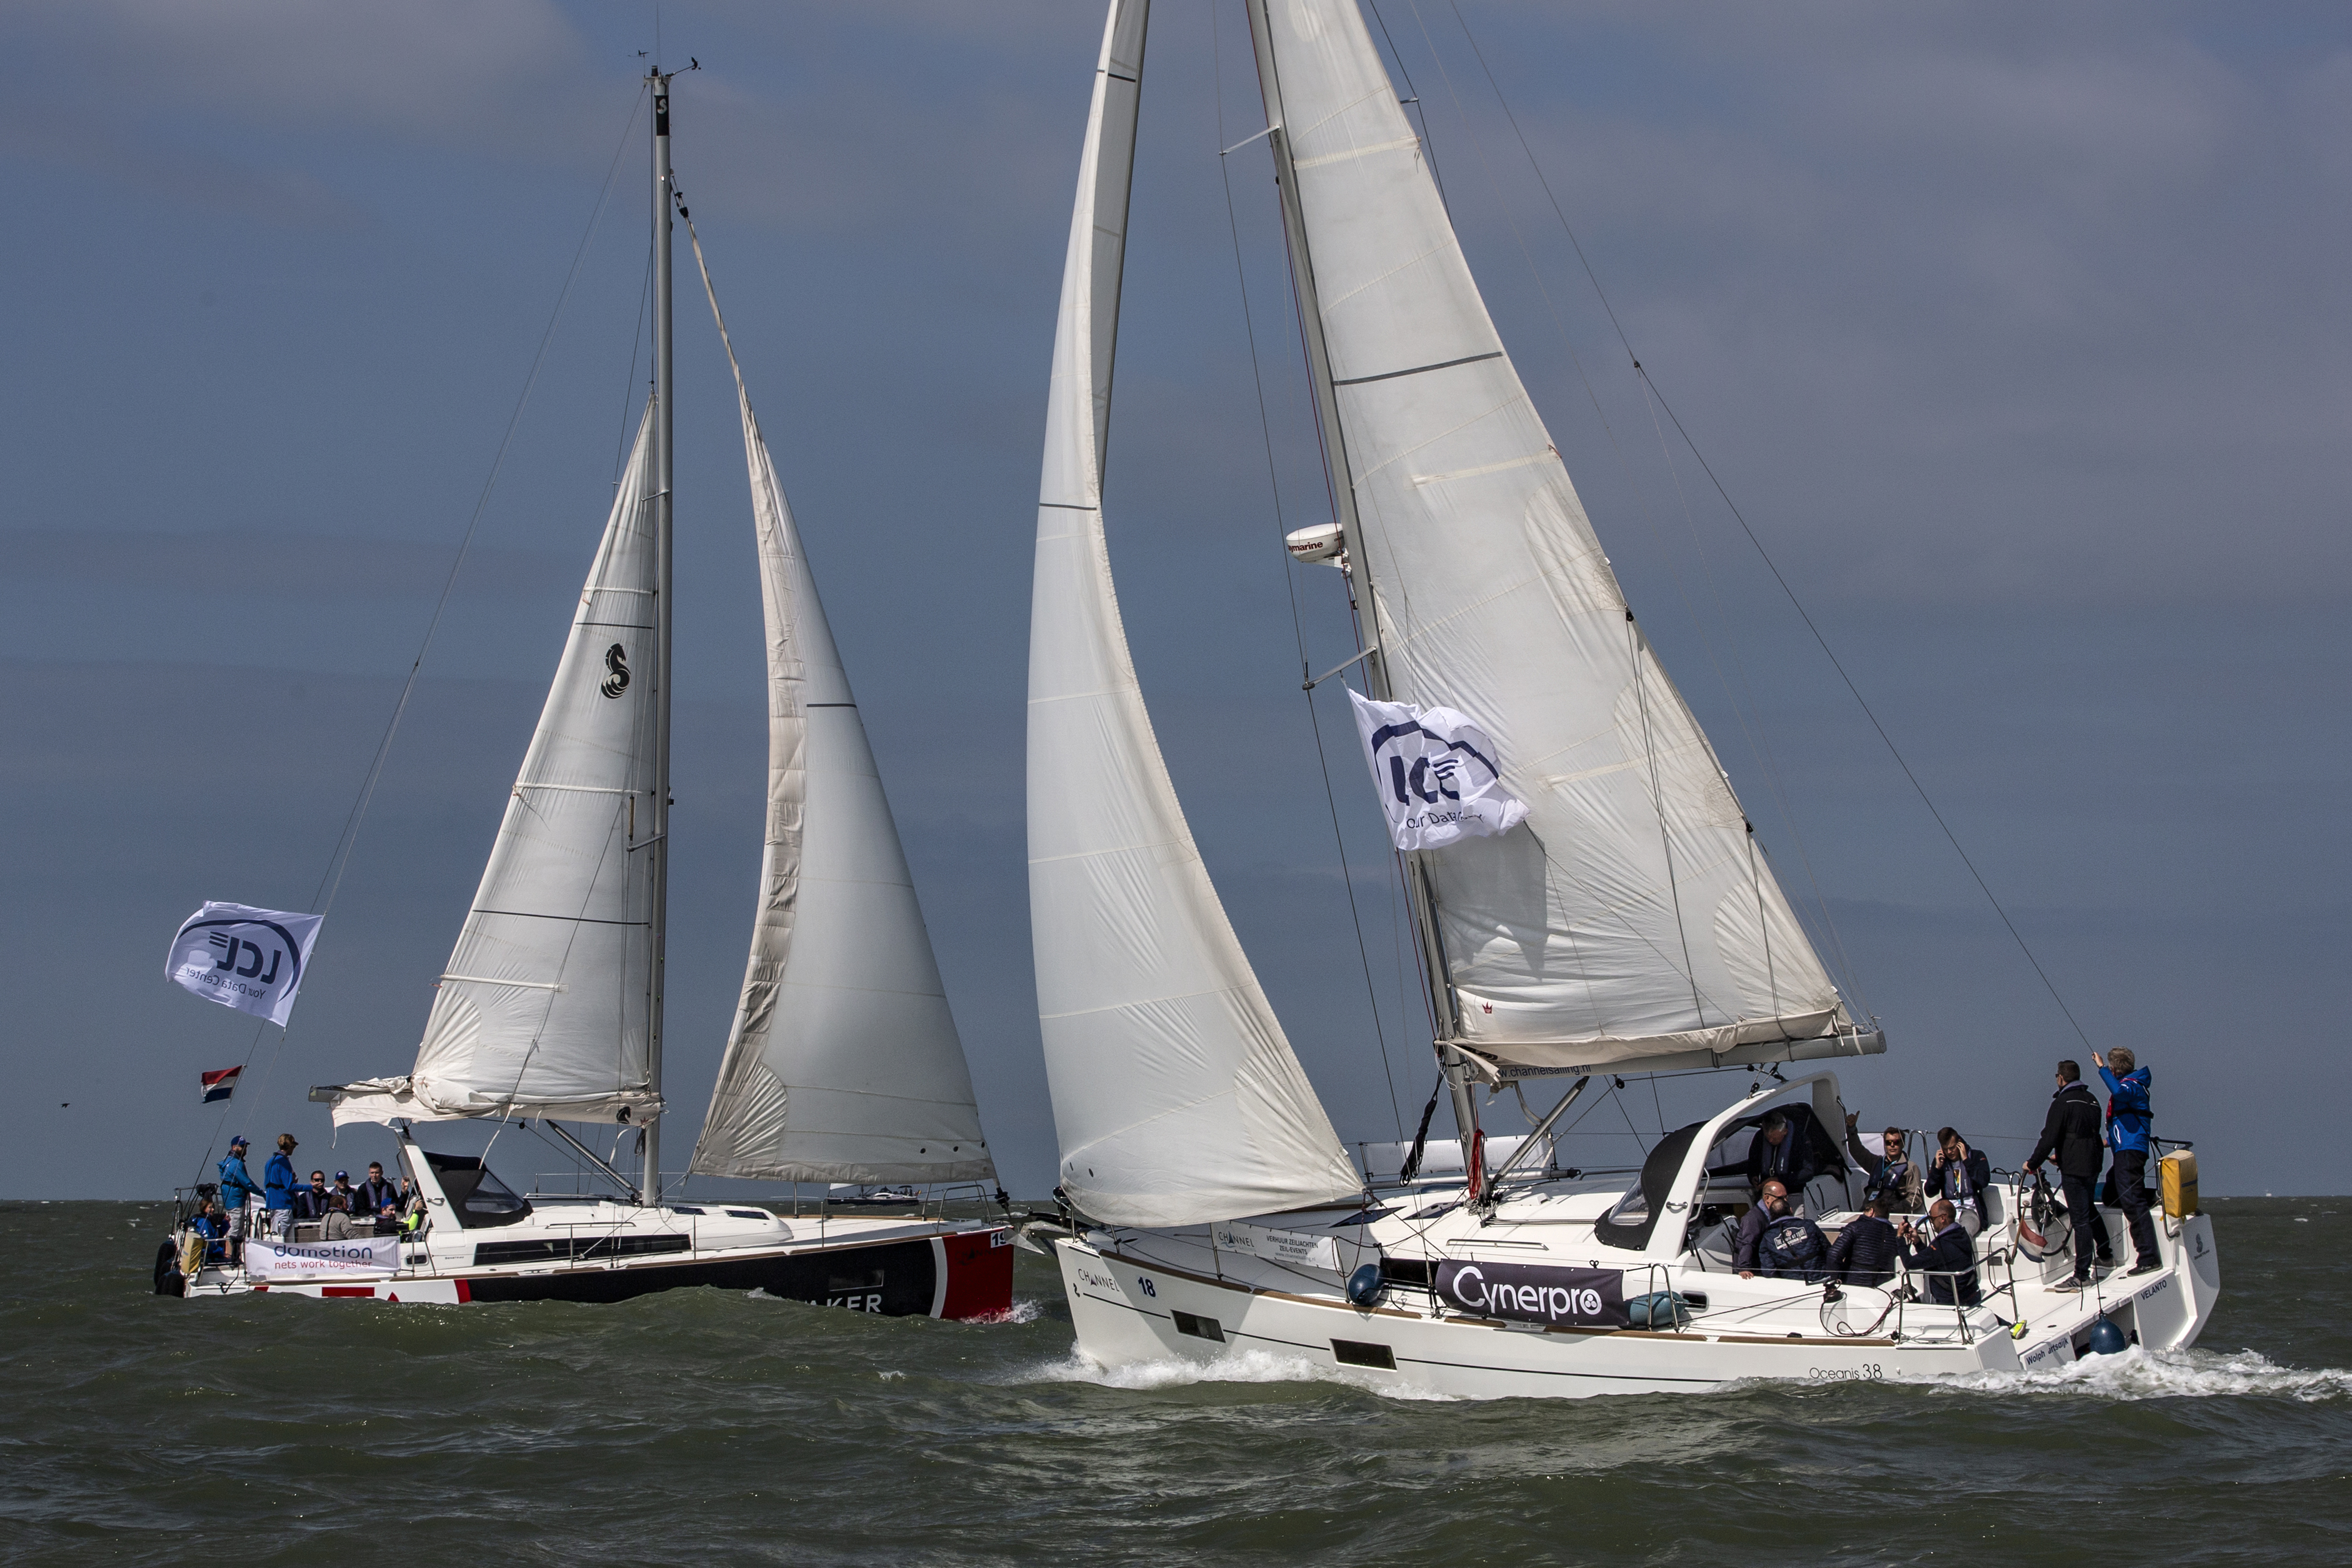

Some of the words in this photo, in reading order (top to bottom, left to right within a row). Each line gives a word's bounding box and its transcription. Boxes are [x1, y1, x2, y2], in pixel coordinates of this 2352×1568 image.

[1288, 542, 1323, 553] aymarine
[1406, 815, 1424, 829] our
[1267, 1235, 1288, 1245] VERHUUR
[274, 1245, 372, 1259] domotion
[275, 1260, 297, 1269] nets
[300, 1259, 325, 1268] work
[329, 1260, 372, 1270] together
[1078, 1269, 1120, 1292] CHANNEL
[1138, 1276, 1156, 1298] 18
[1453, 1266, 1602, 1320] Cynerpro
[2141, 1279, 2167, 1300] VELANTO
[1809, 1367, 1860, 1379] Oceanis
[1862, 1364, 1883, 1379] 38
